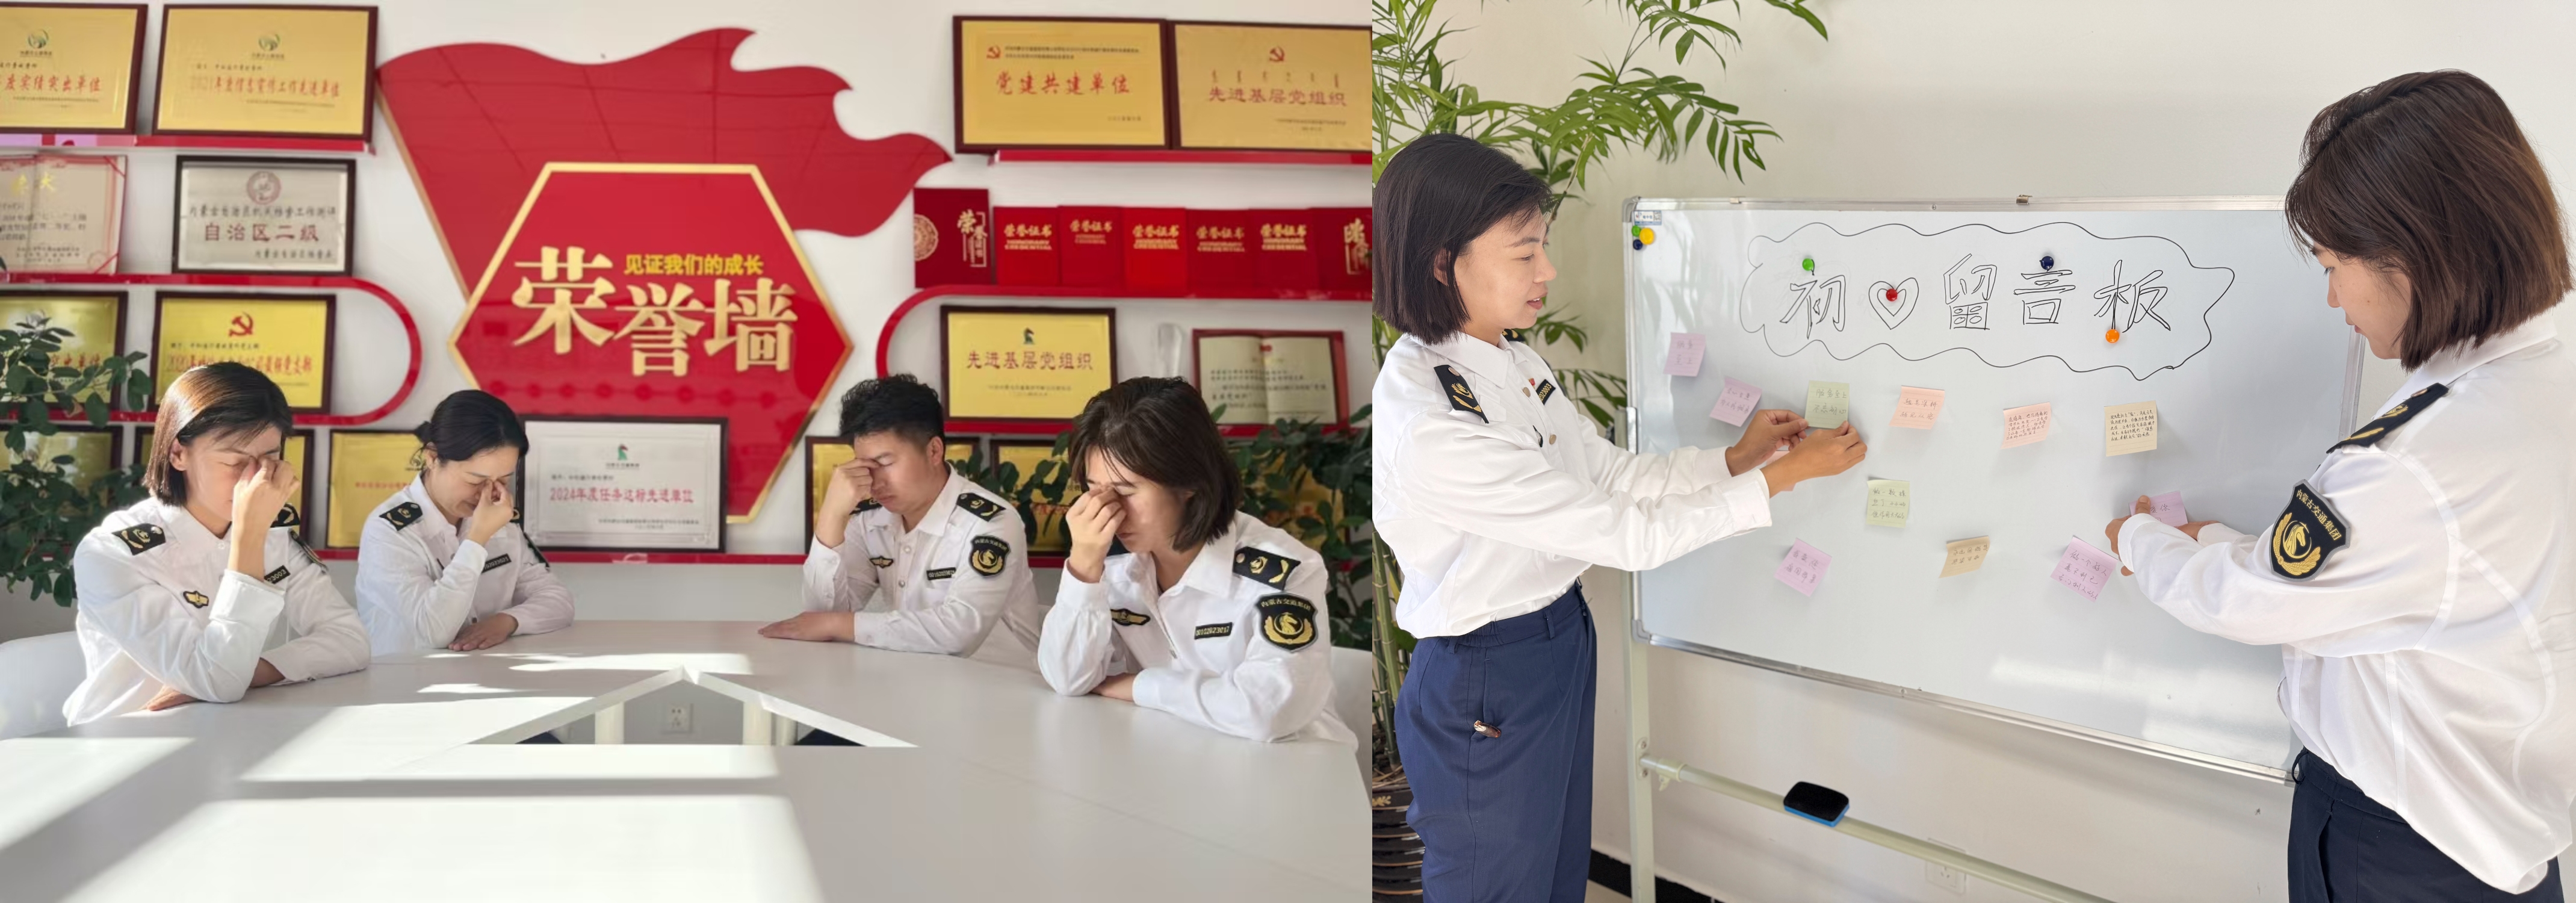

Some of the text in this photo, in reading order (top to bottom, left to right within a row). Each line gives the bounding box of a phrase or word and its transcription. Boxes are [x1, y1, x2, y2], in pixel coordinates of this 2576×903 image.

[0, 73, 101, 92] 度实绩突出单位
[996, 70, 1130, 95] 党建共建单位
[1208, 85, 1347, 107] 先进基层党组织
[205, 222, 319, 242] 自治区二级
[624, 253, 764, 276] 见证我们的成长
[511, 246, 799, 377] 荣誉墙
[967, 350, 1094, 370] 先进基层党组织
[1816, 388, 1847, 399] 服务至上
[1812, 403, 1847, 415] 不忘初心
[2296, 489, 2342, 541] 内蒙古交通集团
[2070, 550, 2107, 576] 做一个好人
